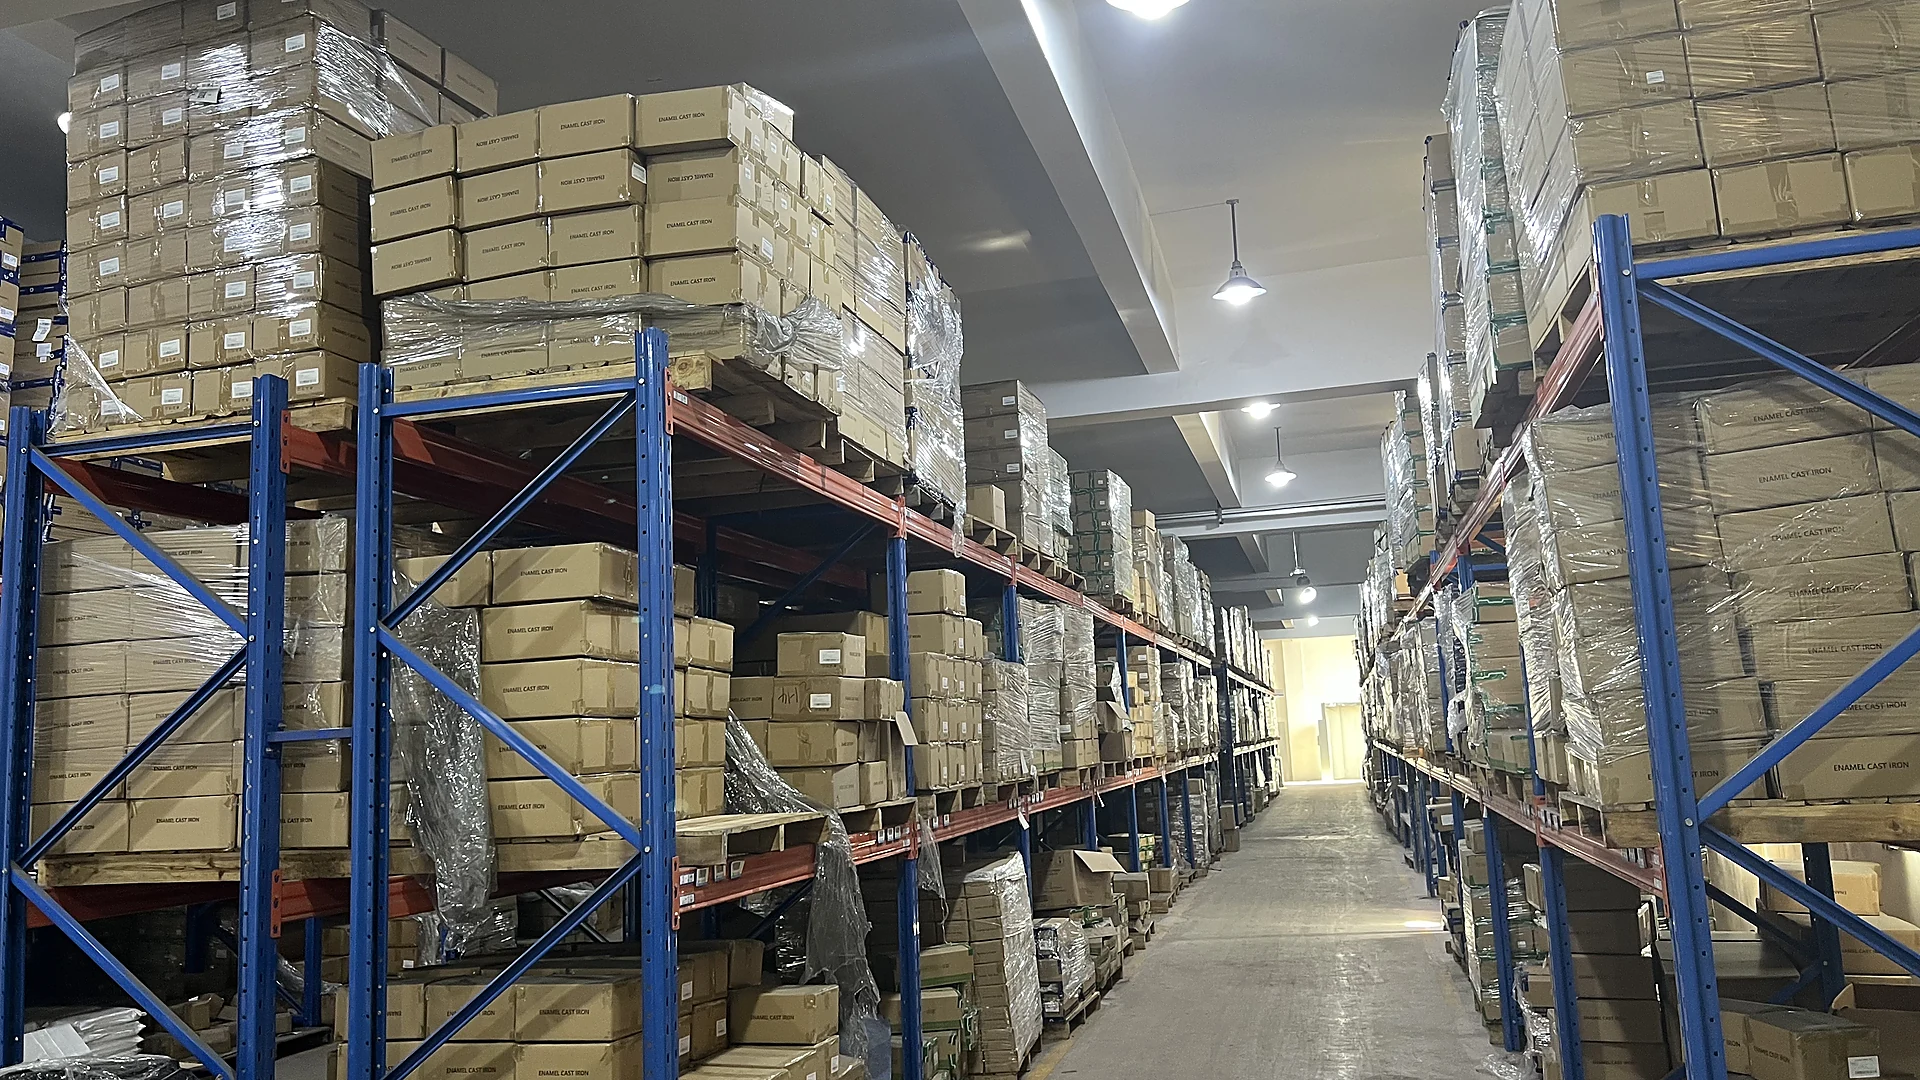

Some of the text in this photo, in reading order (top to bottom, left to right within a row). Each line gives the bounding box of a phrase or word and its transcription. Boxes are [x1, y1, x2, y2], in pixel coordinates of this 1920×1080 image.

[501, 134, 519, 142] ENAMEL
[476, 139, 488, 147] IRON
[391, 154, 408, 163] ENAMEL
[421, 149, 432, 157] IRON
[502, 190, 519, 198] ENAMEL
[477, 195, 489, 203] IRON
[390, 207, 407, 216] ENAMEL
[482, 246, 500, 254] ENAMEL
[415, 256, 432, 265] ENAMEL
[1753, 411, 1783, 422] ENAMEL
[1785, 408, 1804, 418] CAST
[1587, 432, 1615, 443] ENAMEL
[1759, 466, 1832, 483] ENAMEL CAST IRON
[1804, 528, 1823, 537] CAST
[1788, 588, 1818, 597] ENAMEL
[1808, 642, 1882, 654] ENAMEL CAST IRON
[1865, 702, 1884, 710] CAST
[1886, 701, 1907, 709] IRON
[1834, 761, 1909, 772] ENAMEL CAST IRON
